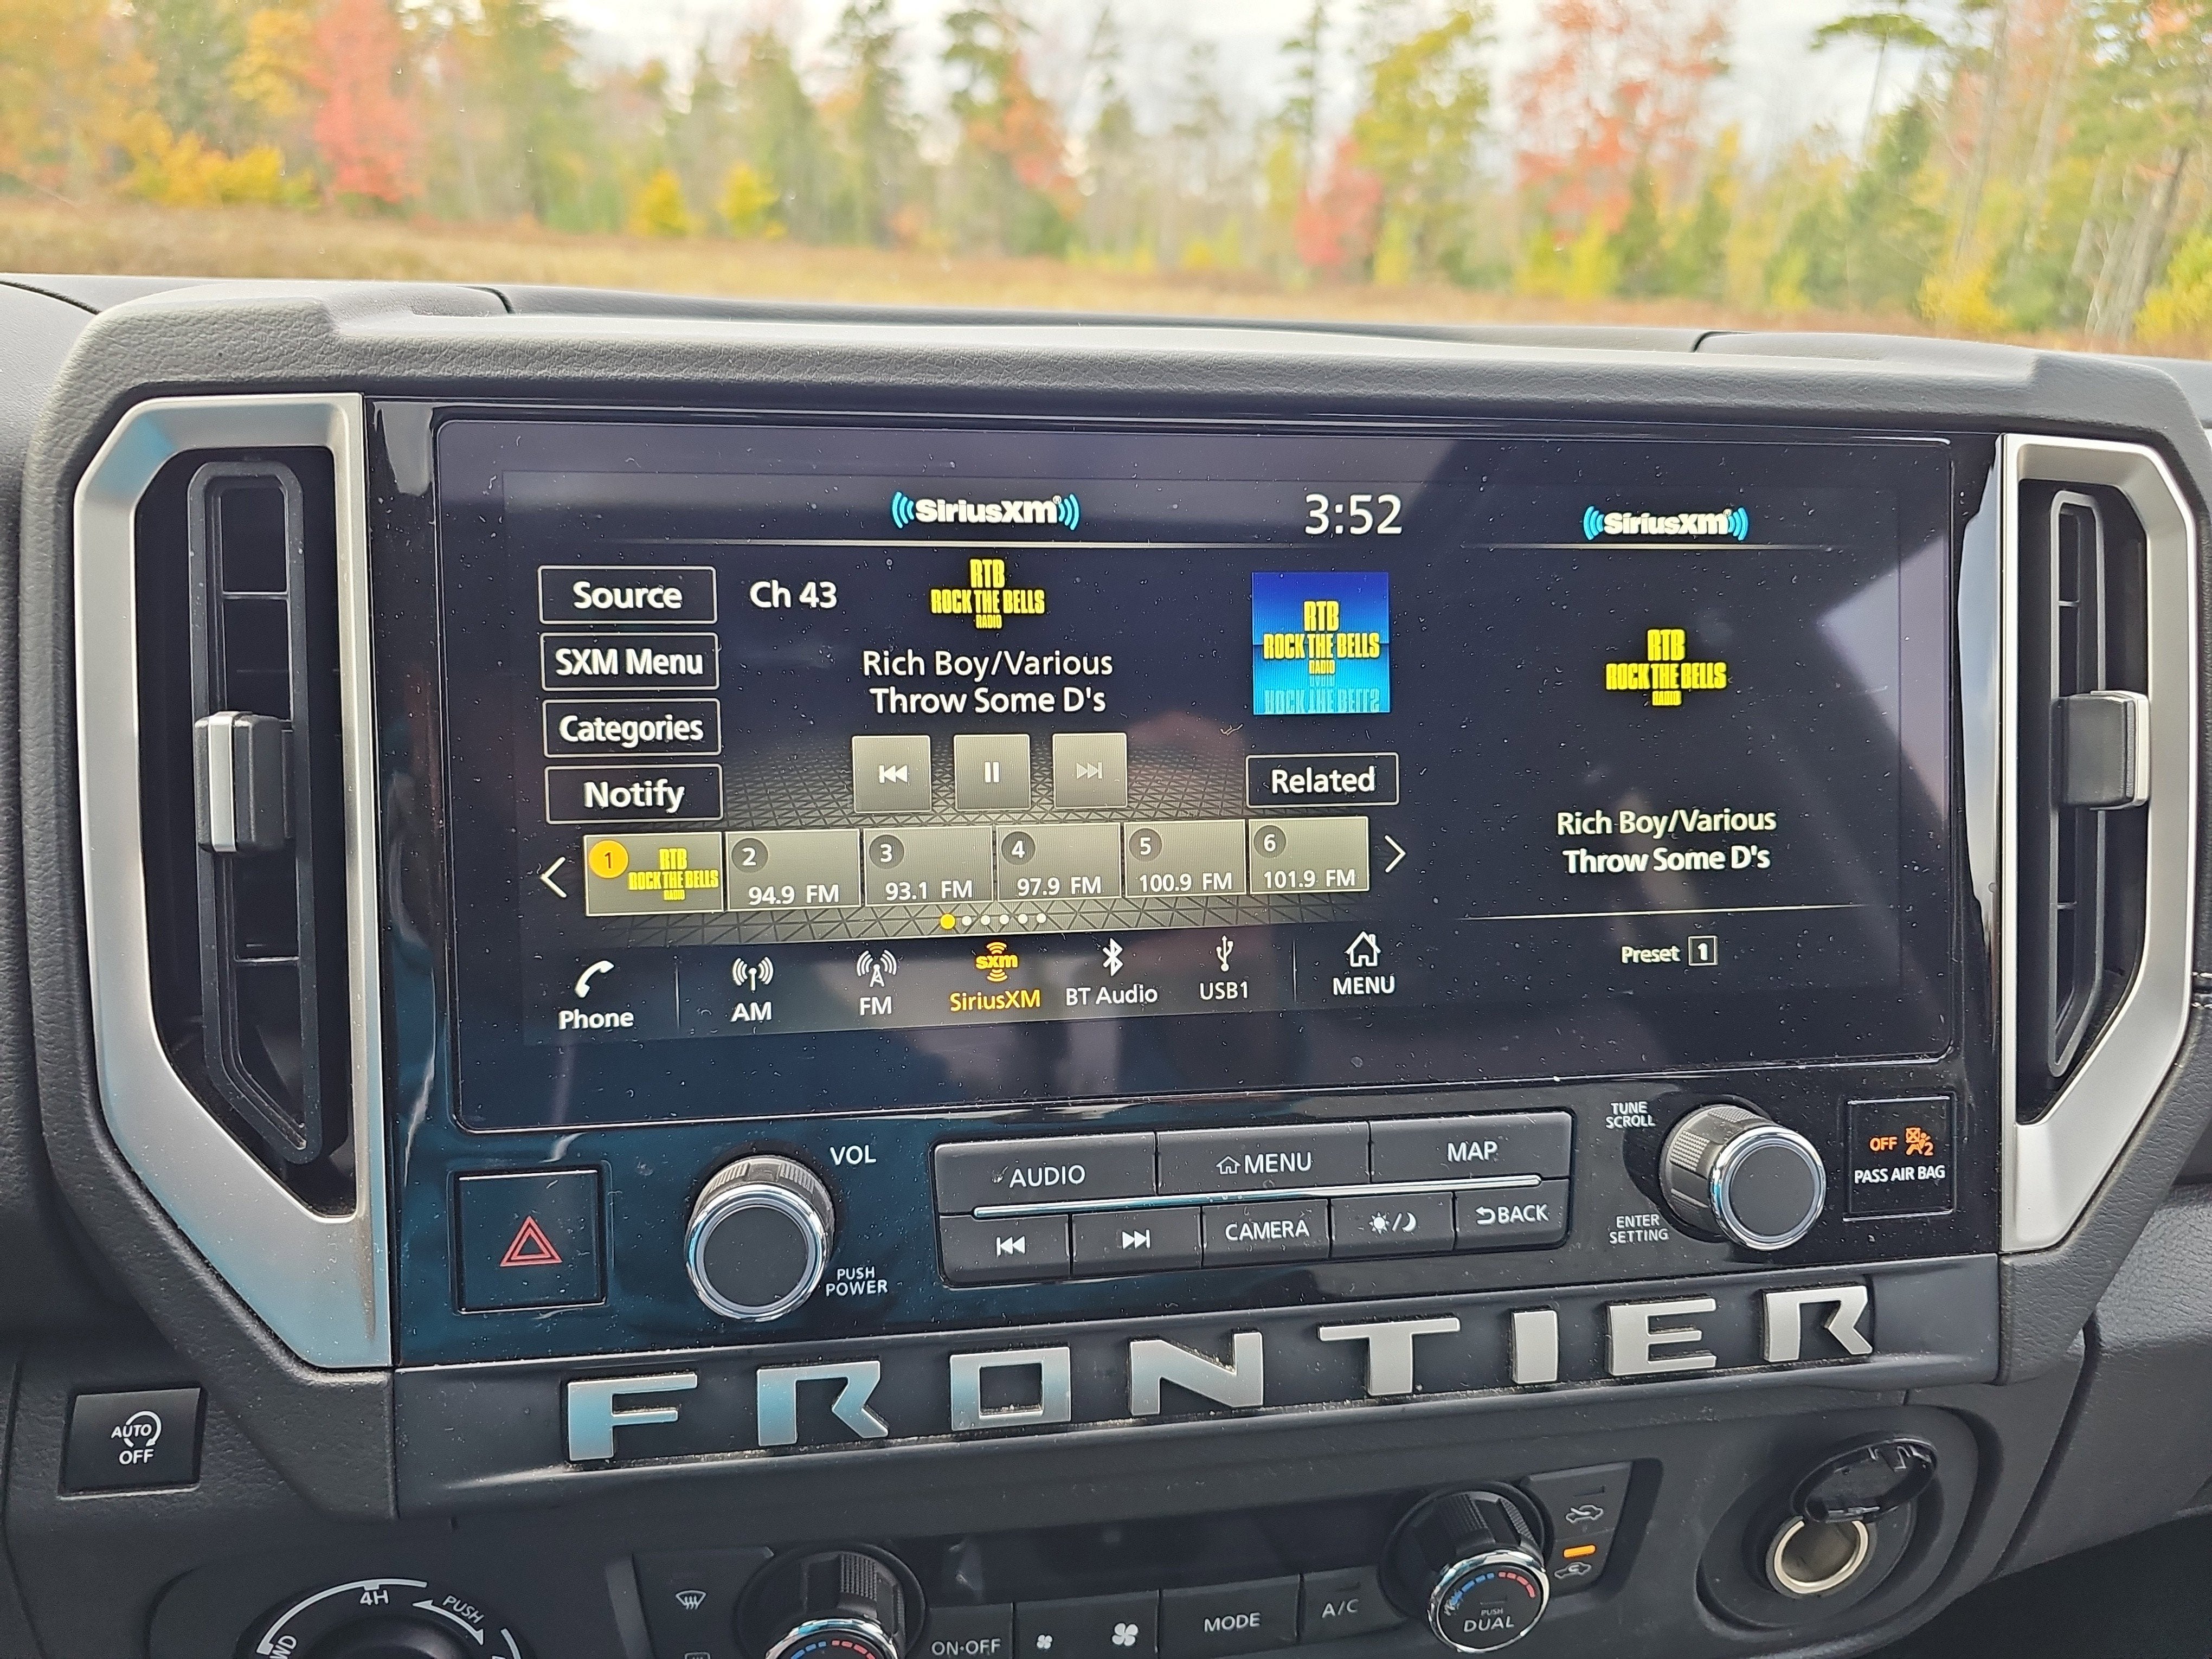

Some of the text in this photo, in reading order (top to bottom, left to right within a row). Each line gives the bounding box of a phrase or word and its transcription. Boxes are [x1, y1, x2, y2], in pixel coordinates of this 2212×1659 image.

[1304, 494, 1403, 535] 3:52
[970, 560, 1005, 588] RTB
[573, 582, 683, 609] Source
[750, 581, 838, 608] Ch 43
[931, 589, 1045, 614] ROCK THE BELLS
[976, 614, 1002, 629] RADIO
[1304, 601, 1339, 631] RTB
[1264, 633, 1380, 659] ROCK THE BELLS
[1647, 629, 1686, 661] RTB
[555, 648, 704, 675] SXM Menu
[864, 650, 1113, 681] Rich Boy/Various
[1309, 660, 1335, 674] RADIO
[1606, 662, 1727, 690] ROCK THE BELLS
[870, 687, 1106, 713] Throw Some D's
[1652, 691, 1682, 706] RADIO
[560, 714, 704, 748] Categories
[1271, 766, 1376, 794] Related
[584, 779, 685, 813] Notify
[1558, 808, 1777, 839] Rich Boy/Various
[1012, 841, 1025, 858] 4
[1140, 837, 1152, 855] 5
[1263, 834, 1276, 851] 6
[604, 852, 612, 869] 1
[659, 848, 687, 870] RTB
[742, 847, 757, 866] 2
[880, 844, 892, 862] 3
[1563, 845, 1771, 873] Throw Some D's
[629, 870, 719, 890] ROCK THE BELLS
[1017, 876, 1101, 896] 97.9 FM
[1140, 872, 1232, 892] 100.9 FM
[1264, 869, 1355, 889] 101.9 FM
[749, 884, 839, 905] 94.9 FM
[885, 880, 973, 901] 93.1 FM
[976, 955, 1018, 969] sxm
[1622, 942, 1709, 964] Preset 1
[1066, 984, 1158, 1006] BT Audio
[1199, 981, 1249, 1001] USB1
[1333, 975, 1396, 995] MENU
[860, 996, 892, 1015] FM
[950, 989, 1041, 1011] SiriusXM
[558, 1009, 634, 1030] Phone
[730, 1002, 772, 1022] AM
[1611, 1101, 1648, 1115] TUNE
[1605, 1114, 1656, 1129] SCROLL
[1446, 1141, 1498, 1162] MAP
[1870, 1136, 1898, 1151] OFF
[829, 1146, 877, 1165] VOL
[1244, 1152, 1312, 1174] MENU
[1009, 1165, 1085, 1188] AUDIO
[1854, 1165, 1945, 1184] PASS AIR BAG
[1497, 1204, 1549, 1224] BACK
[1616, 1214, 1660, 1229] ENTER
[1225, 1219, 1310, 1241] CAMERA
[1609, 1227, 1669, 1243] SETTING
[837, 1266, 875, 1281] PUSH
[826, 1279, 888, 1296] POWER
[567, 1285, 1873, 1461] FRONTIER
[111, 1424, 152, 1438] AUTO
[119, 1449, 154, 1464] OFF
[359, 1590, 389, 1606] 4H
[442, 1595, 485, 1624] PUSH
[1322, 1599, 1359, 1618] A/C
[1481, 1607, 1504, 1616] PUSH
[1204, 1612, 1261, 1632] MODE
[1464, 1615, 1515, 1633] DUAL
